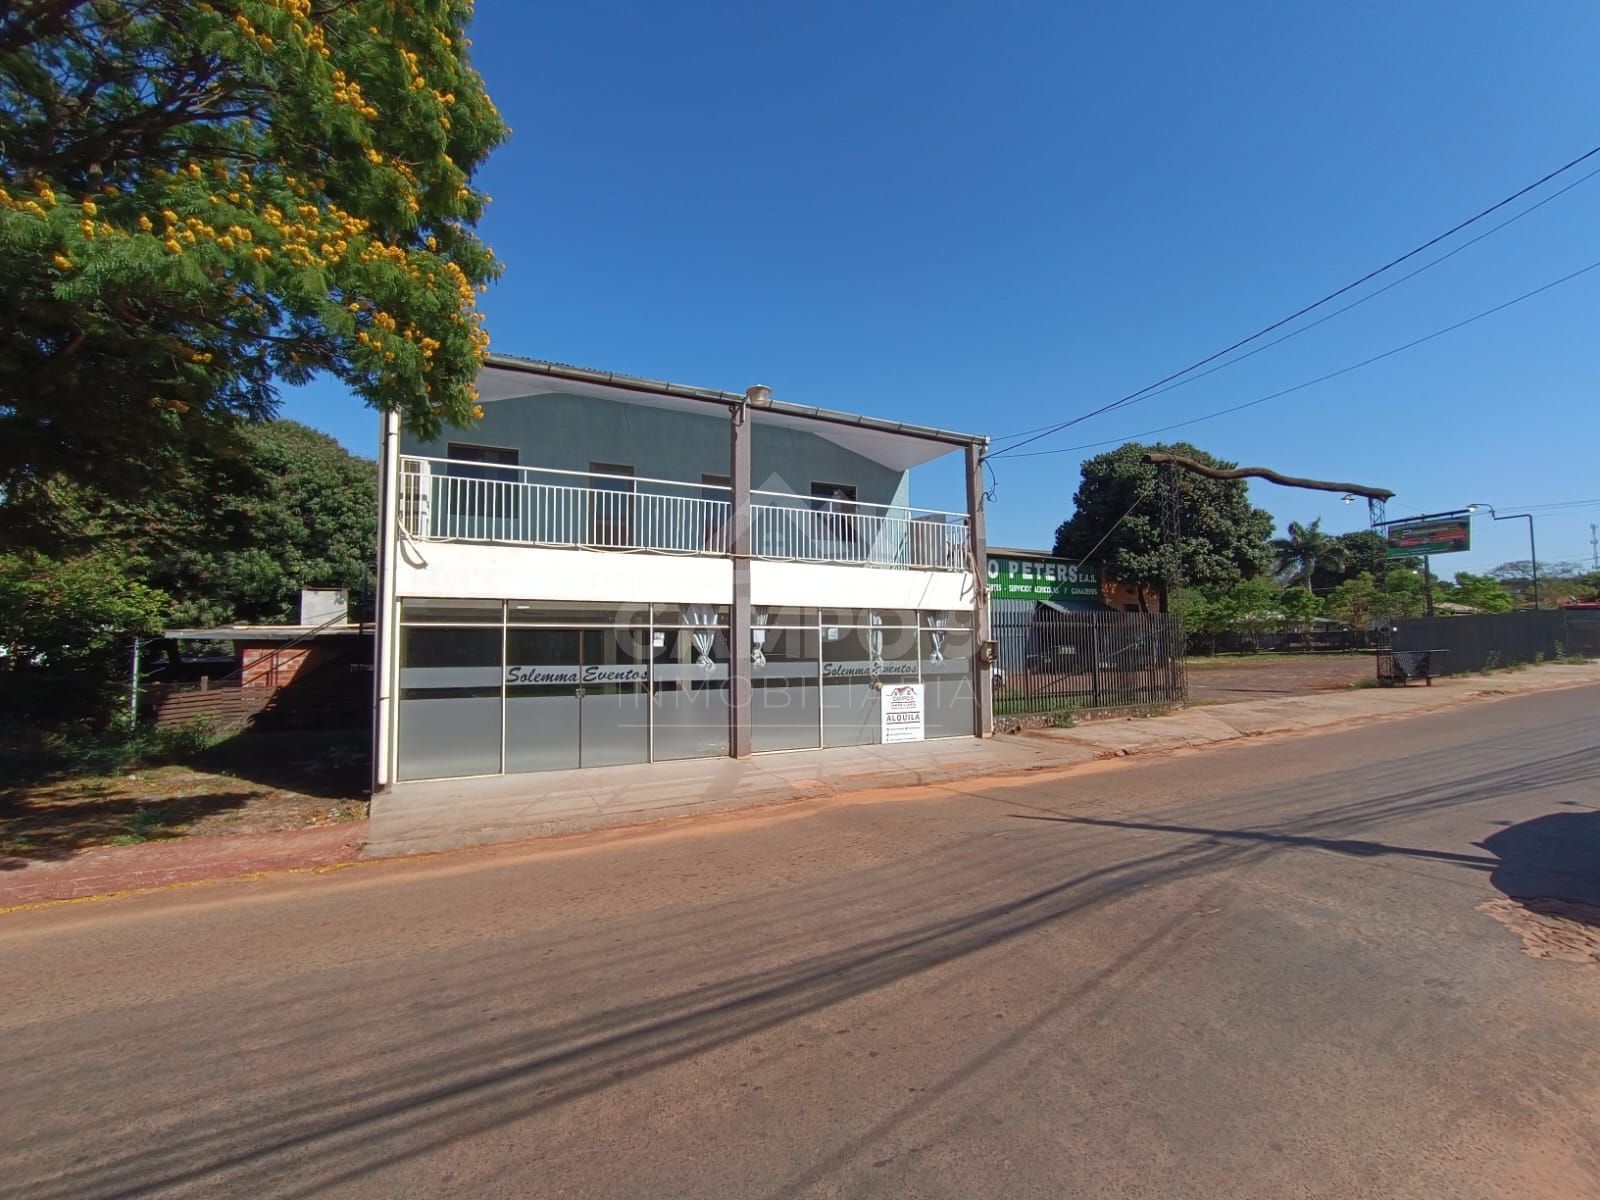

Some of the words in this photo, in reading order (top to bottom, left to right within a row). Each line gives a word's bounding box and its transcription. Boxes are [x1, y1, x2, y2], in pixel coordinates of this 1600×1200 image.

[1008, 560, 1078, 583] PETERS
[506, 666, 578, 683] Solemma
[583, 666, 648, 682] Eventos
[823, 663, 870, 676] Solemma
[887, 713, 920, 722] ALQUILA
